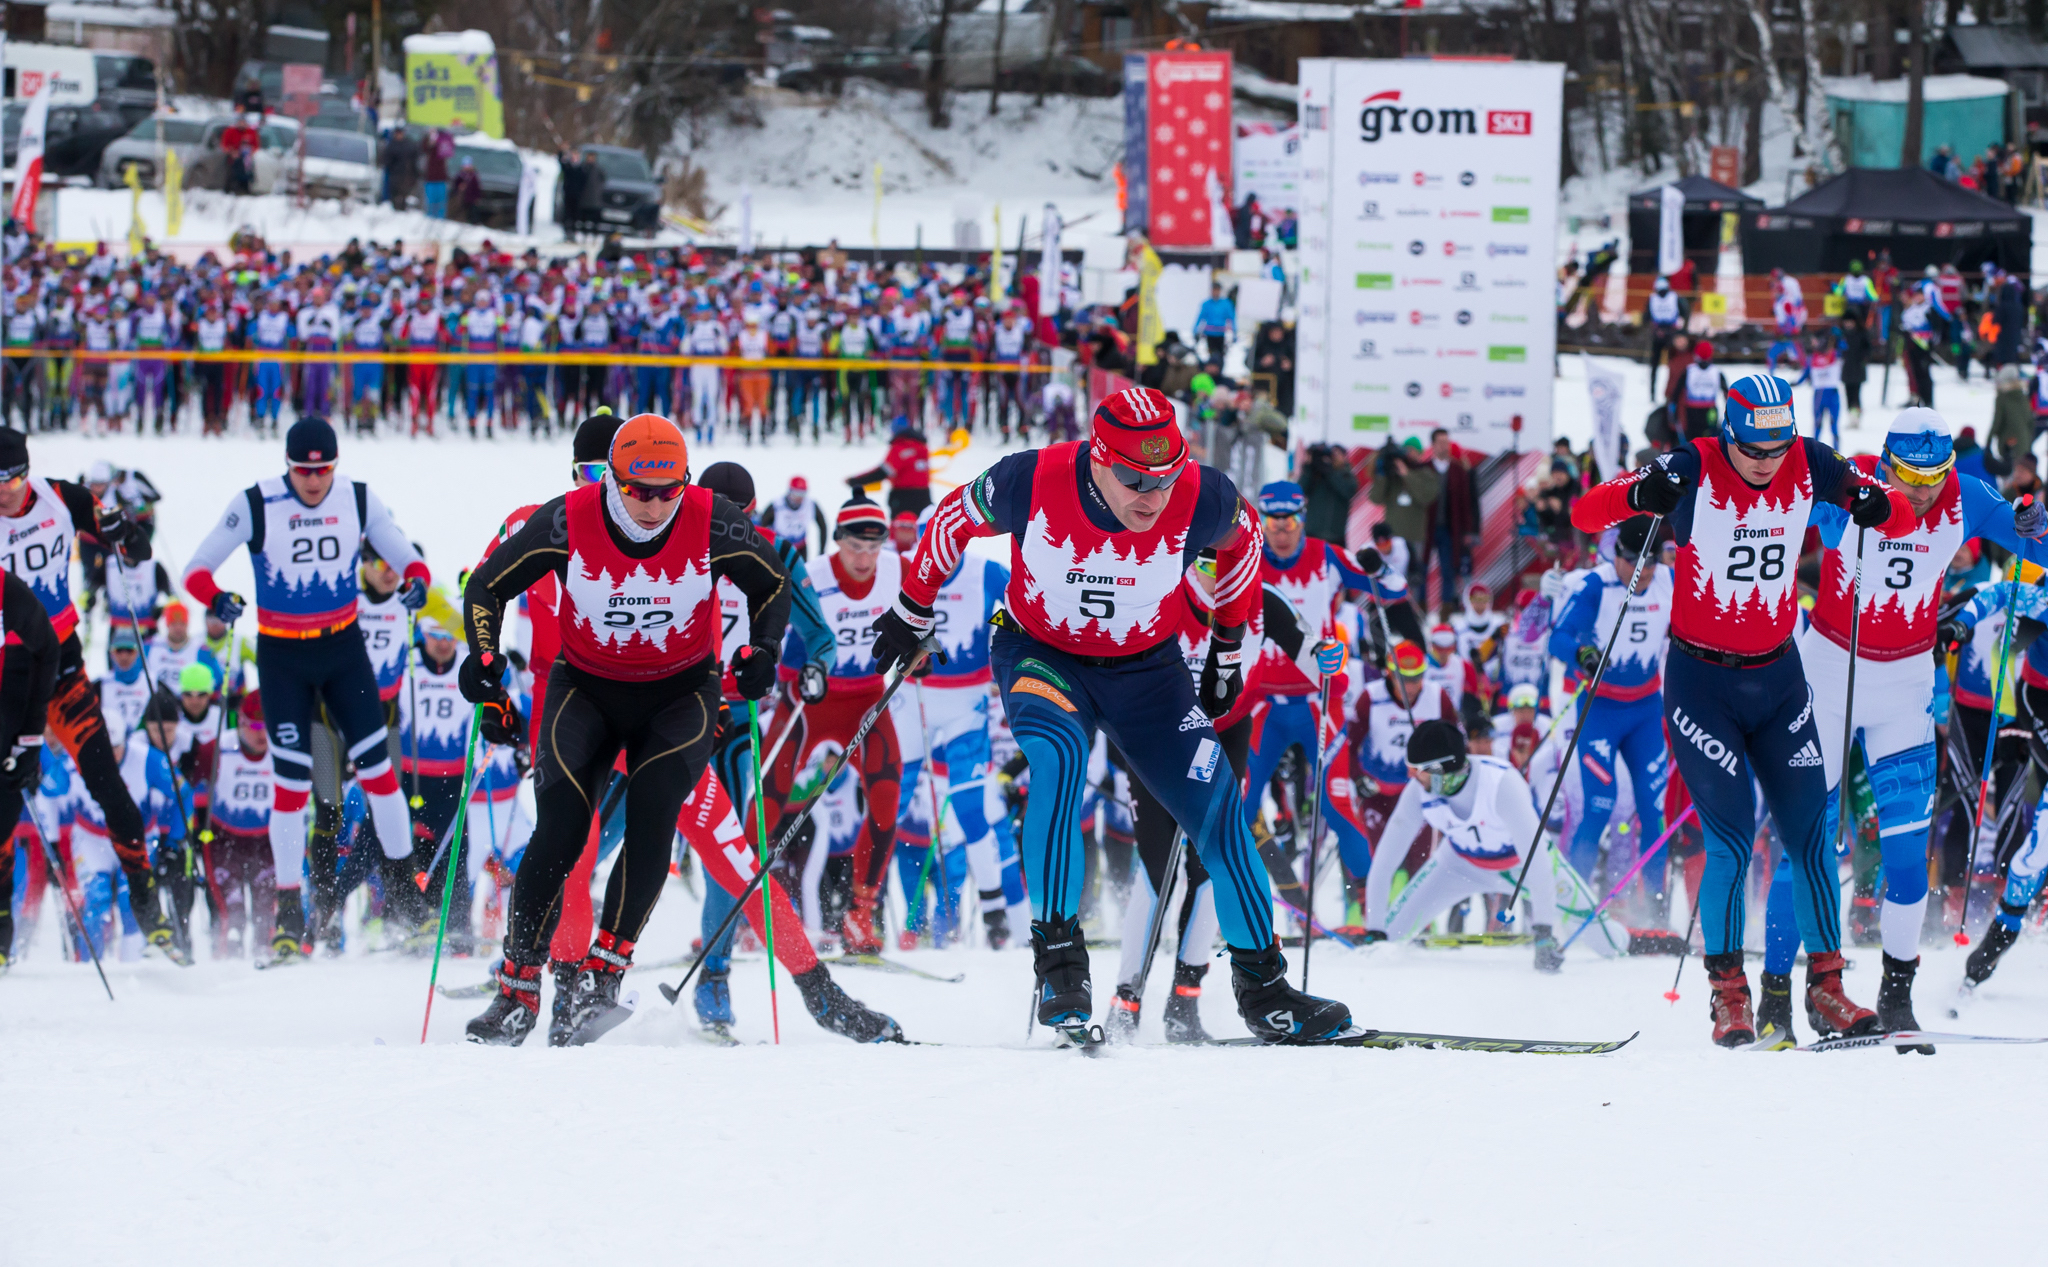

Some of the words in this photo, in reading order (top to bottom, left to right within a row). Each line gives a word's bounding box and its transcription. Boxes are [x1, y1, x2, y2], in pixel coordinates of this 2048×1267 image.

[1361, 105, 1477, 142] grom
[1491, 113, 1526, 133] SKI
[1755, 407, 1787, 416] SQUEEZY
[1756, 419, 1790, 428] NUTRITION
[1087, 481, 1108, 510] alpari
[289, 518, 323, 530] grom
[1734, 528, 1769, 541] grom
[0, 533, 64, 574] 104
[292, 536, 340, 563] 20
[1878, 540, 1913, 552] grom
[1727, 544, 1785, 582] 28
[1066, 572, 1113, 585] grom
[1885, 557, 1914, 590] 3
[608, 596, 651, 608] grom
[1079, 589, 1115, 620] 5
[603, 610, 674, 630] 22
[837, 626, 881, 646] 35
[1630, 622, 1648, 643] 5
[420, 698, 453, 719] 18
[1178, 719, 1214, 732] adida
[1672, 706, 1738, 777] LUKOIL
[1812, 1037, 1881, 1052] MADSHUS
